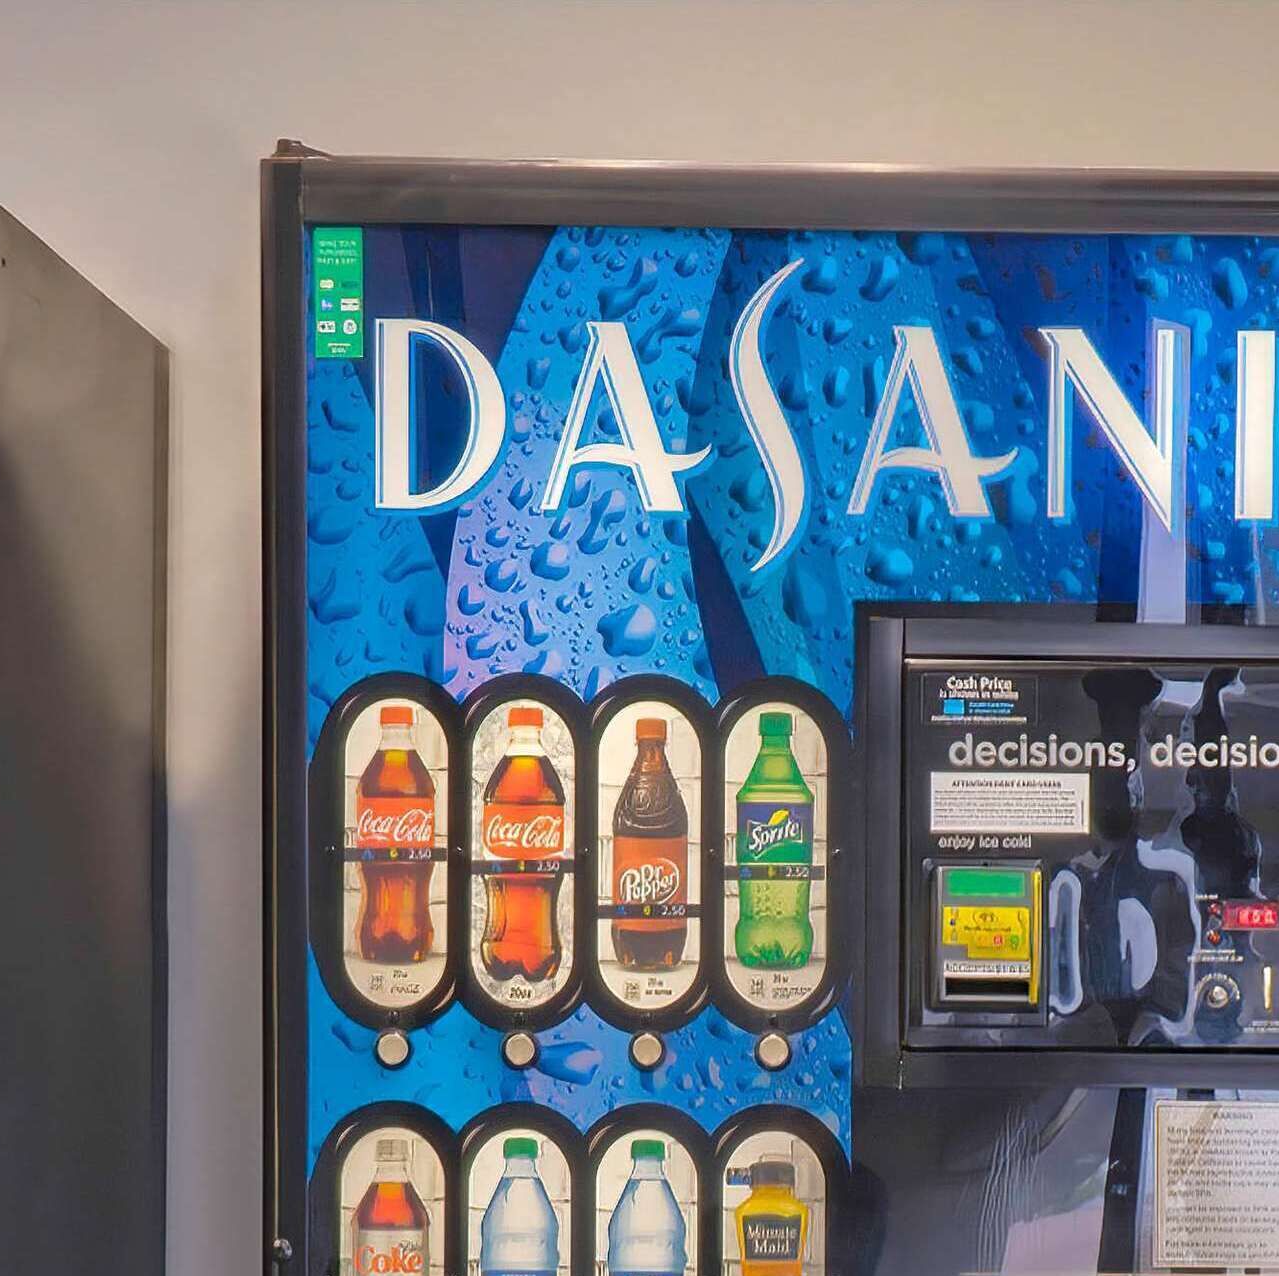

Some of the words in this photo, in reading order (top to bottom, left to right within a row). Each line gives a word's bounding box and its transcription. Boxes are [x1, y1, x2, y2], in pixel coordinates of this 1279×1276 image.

[946, 675, 978, 690] Cash
[980, 676, 1012, 690] Price
[949, 732, 1136, 773] decisions,
[358, 809, 433, 842] Coca-Cola
[487, 814, 561, 848] Coca-Cola
[749, 818, 800, 852] Sprite
[937, 834, 976, 850] enjoy
[354, 1244, 424, 1276] Coke
